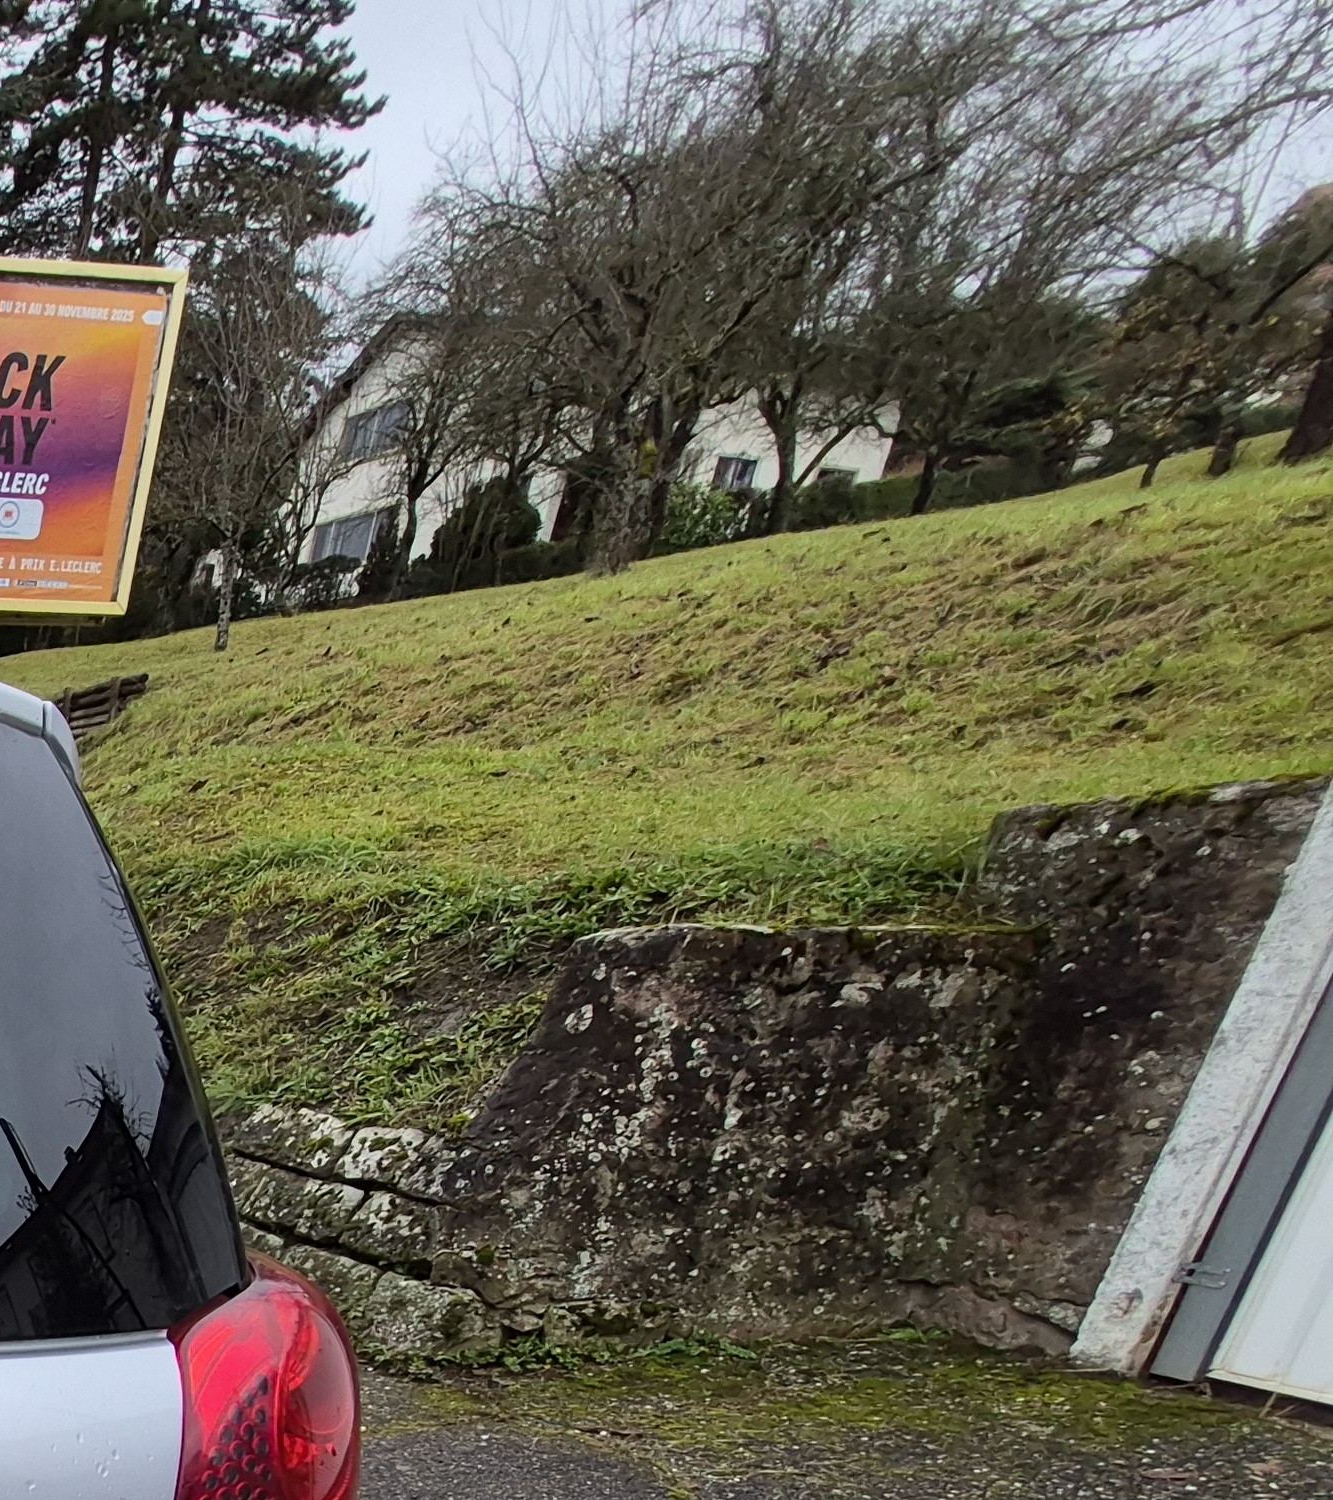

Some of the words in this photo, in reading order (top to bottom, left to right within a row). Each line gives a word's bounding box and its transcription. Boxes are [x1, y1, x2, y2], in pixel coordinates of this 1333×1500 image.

[0, 300, 13, 313] DU
[14, 302, 26, 314] 21
[28, 303, 42, 315] AU
[43, 304, 56, 316] 30
[57, 305, 109, 320] NOVEMBRE
[110, 309, 135, 322] 2025
[8, 556, 16, 570] À
[20, 559, 45, 571] PRIX
[49, 560, 103, 575] E.LECLERC
